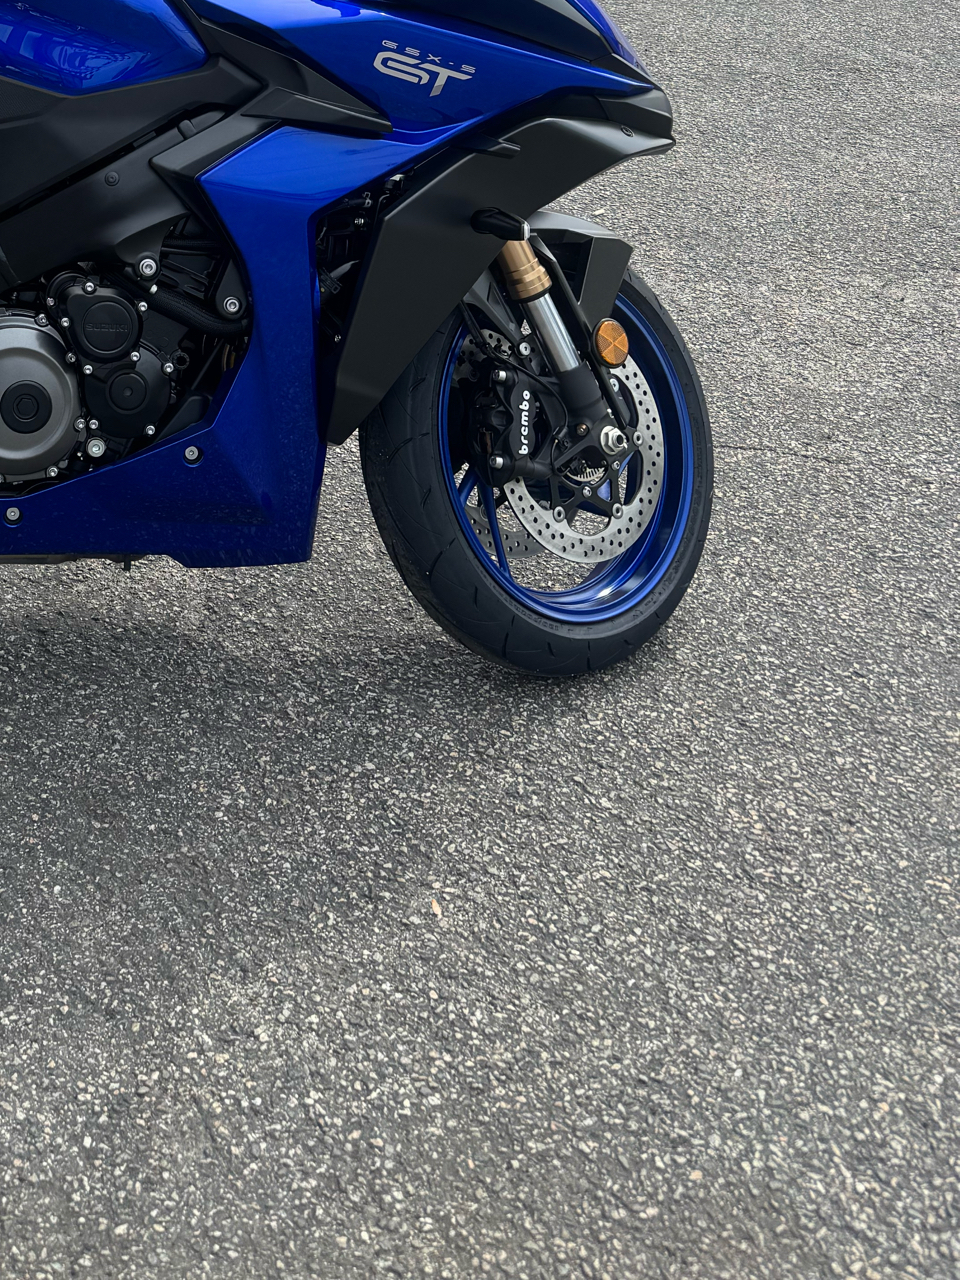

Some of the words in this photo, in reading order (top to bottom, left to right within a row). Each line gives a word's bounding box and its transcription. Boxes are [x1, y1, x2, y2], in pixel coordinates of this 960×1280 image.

[373, 51, 472, 97] GT
[85, 323, 128, 332] SUZUKI
[518, 390, 530, 455] brembo
